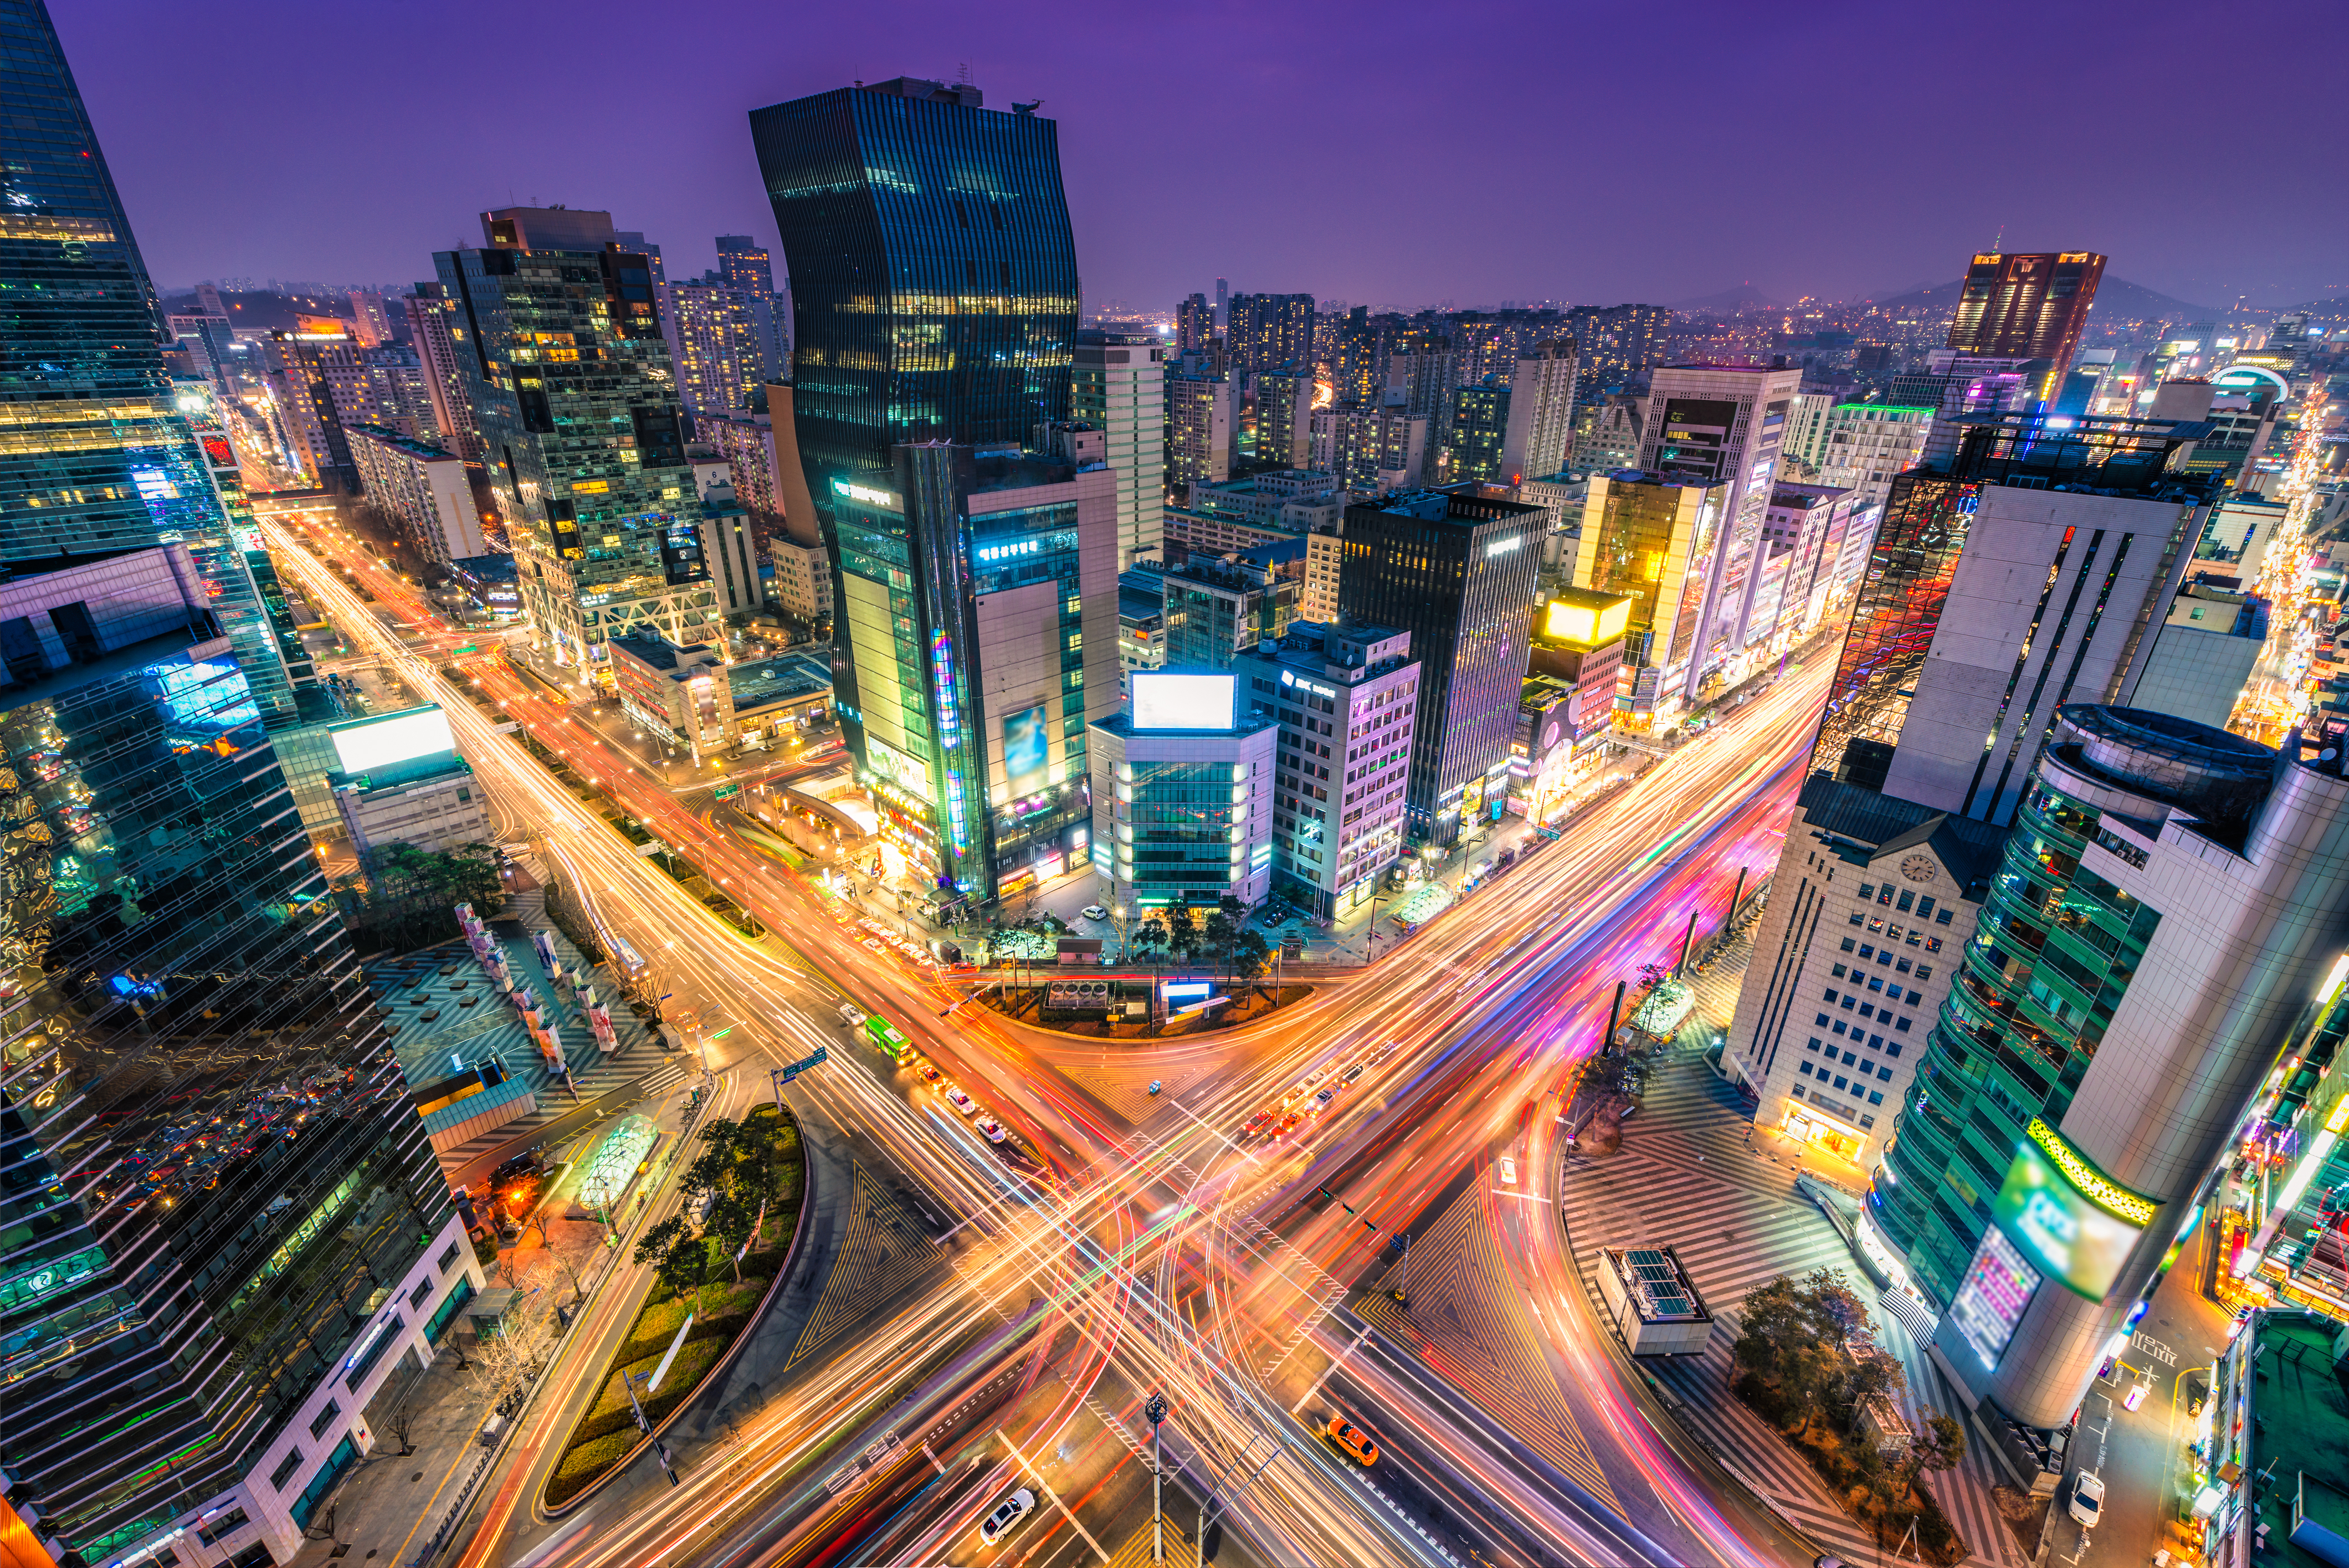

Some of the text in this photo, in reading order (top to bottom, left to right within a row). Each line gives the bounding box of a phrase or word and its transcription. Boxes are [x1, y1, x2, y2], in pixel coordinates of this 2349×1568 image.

[2131, 1330, 2178, 1367] 직진금지
[864, 1430, 909, 1476] 버스전용
[824, 1459, 870, 1507] 24시간
